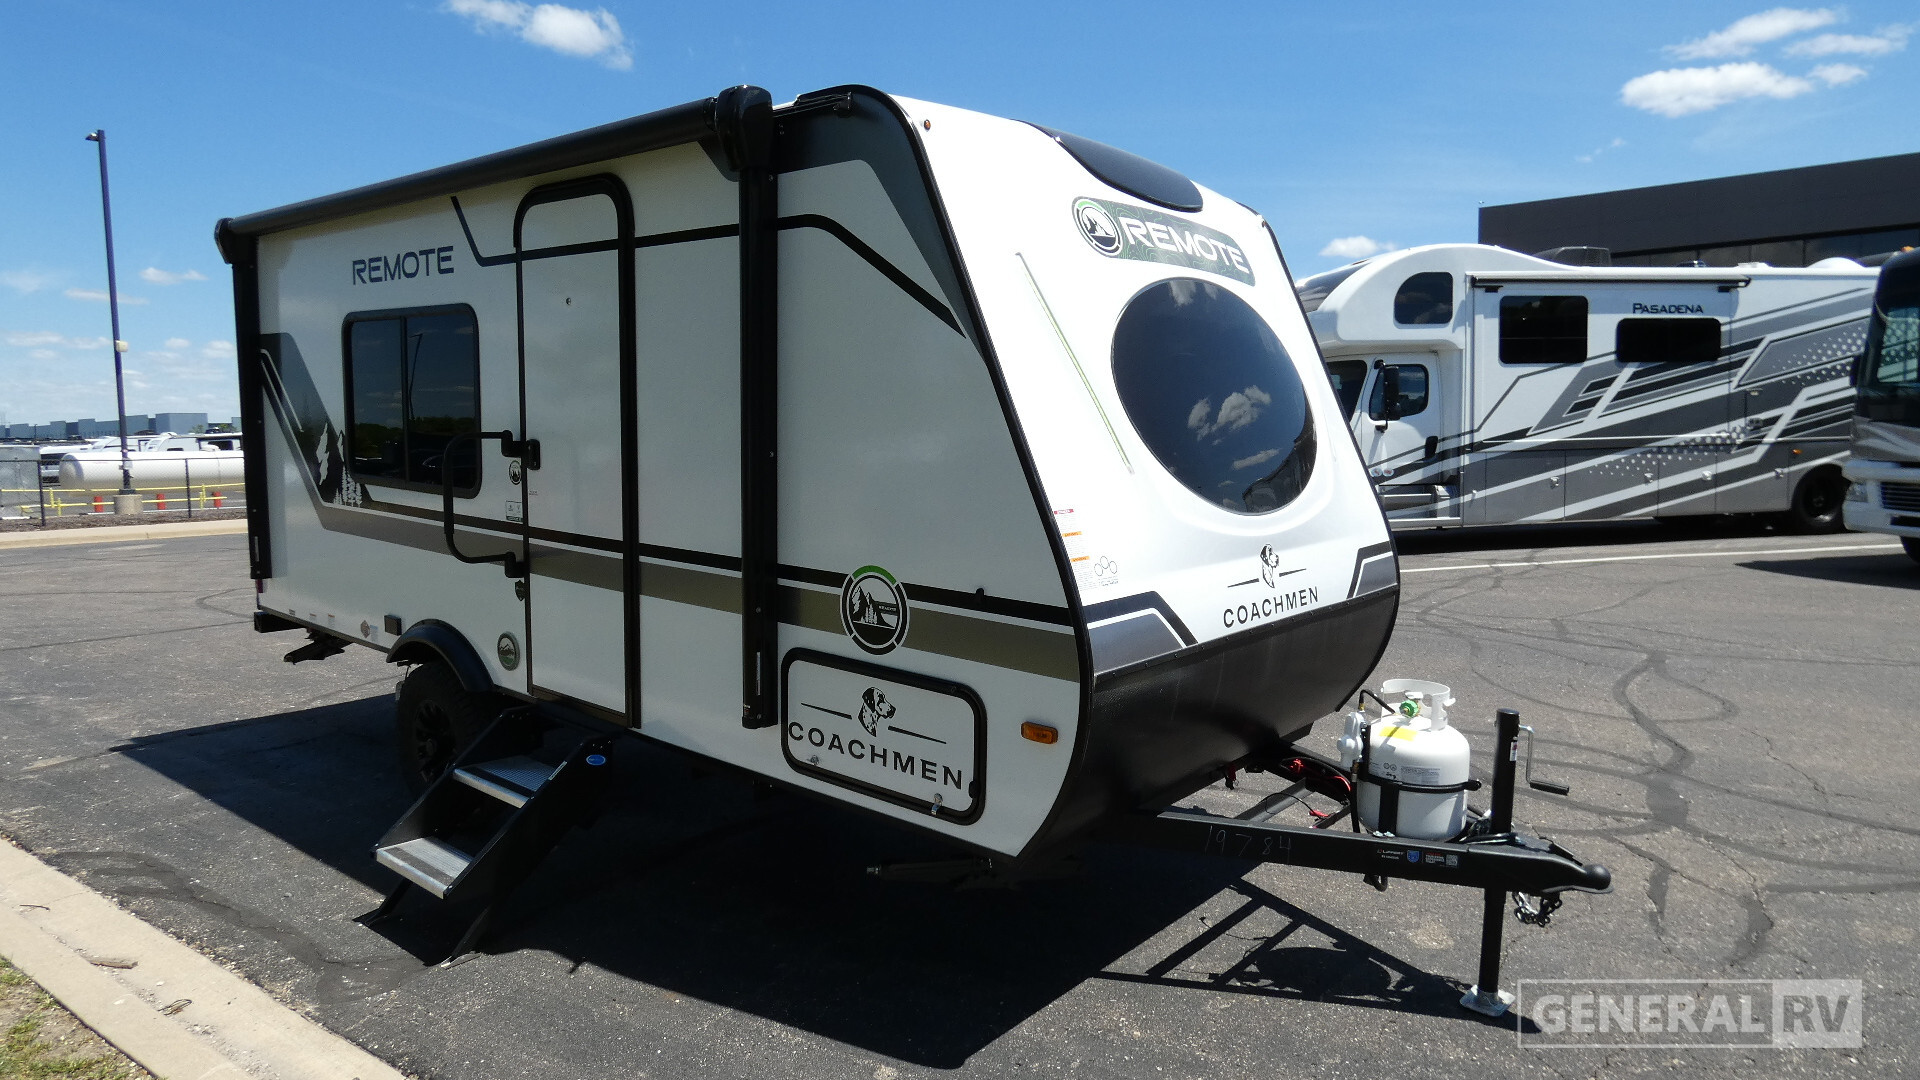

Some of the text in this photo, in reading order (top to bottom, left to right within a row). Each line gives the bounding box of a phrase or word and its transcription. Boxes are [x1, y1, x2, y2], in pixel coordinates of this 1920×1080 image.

[352, 245, 455, 285] REMOTE
[1118, 216, 1250, 274] REMOTE
[1632, 302, 1704, 314] PASADENA
[1222, 586, 1319, 628] COACHMEN
[788, 721, 963, 790] COACHMEN
